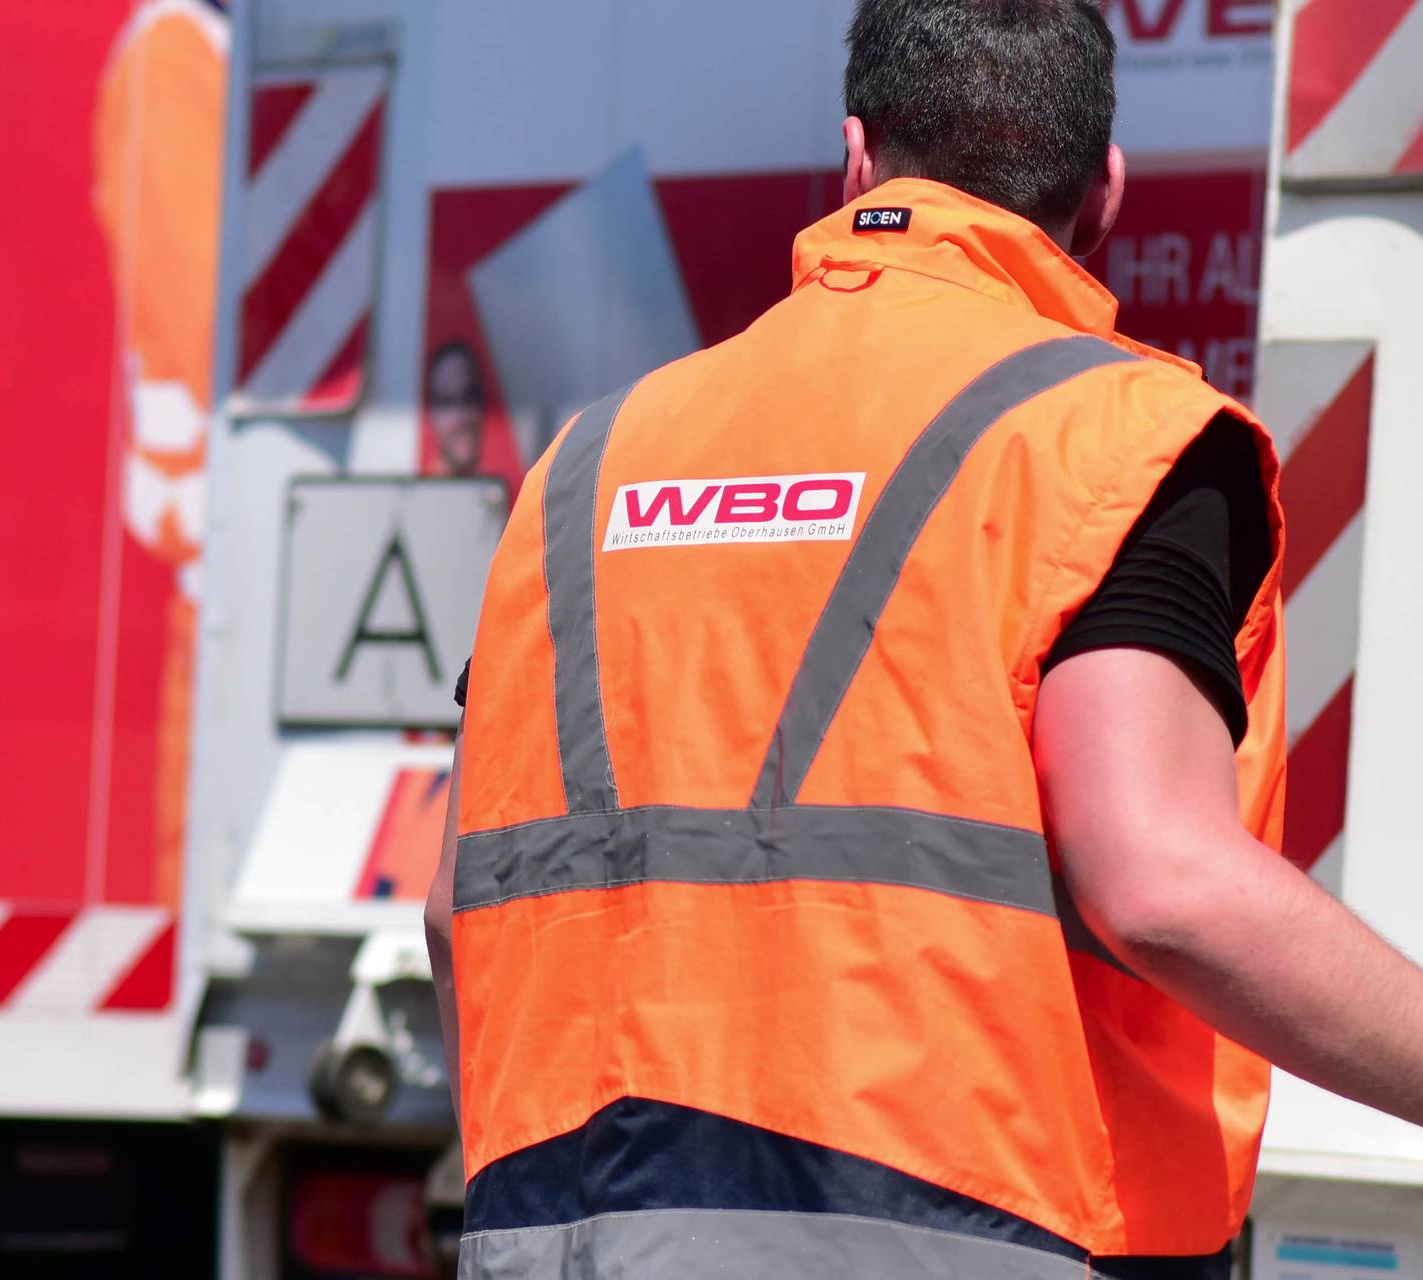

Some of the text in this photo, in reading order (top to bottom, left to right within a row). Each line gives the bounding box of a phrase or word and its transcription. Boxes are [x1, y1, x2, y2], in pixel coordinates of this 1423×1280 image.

[859, 211, 902, 226] SIOEN
[625, 479, 854, 528] WBO
[611, 522, 846, 545] Wirtschaftsbetriebe Oberhausen GmbH
[333, 533, 443, 683] A
